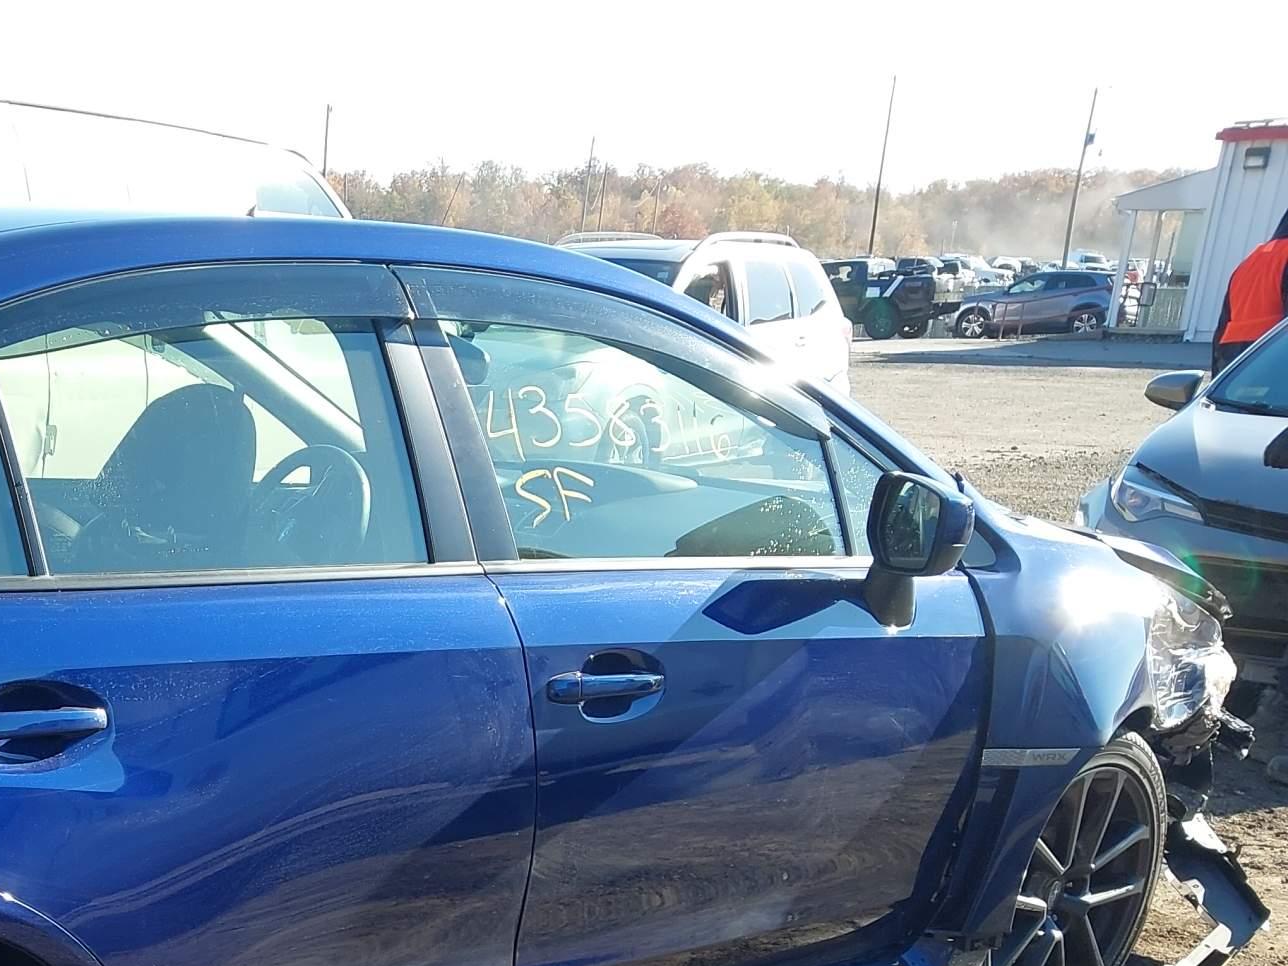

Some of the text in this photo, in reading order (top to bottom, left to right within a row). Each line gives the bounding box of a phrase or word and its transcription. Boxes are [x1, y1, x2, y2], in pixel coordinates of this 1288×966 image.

[485, 385, 731, 462] 43583116
[514, 467, 595, 528] SF
[1032, 752, 1067, 761] WRX
